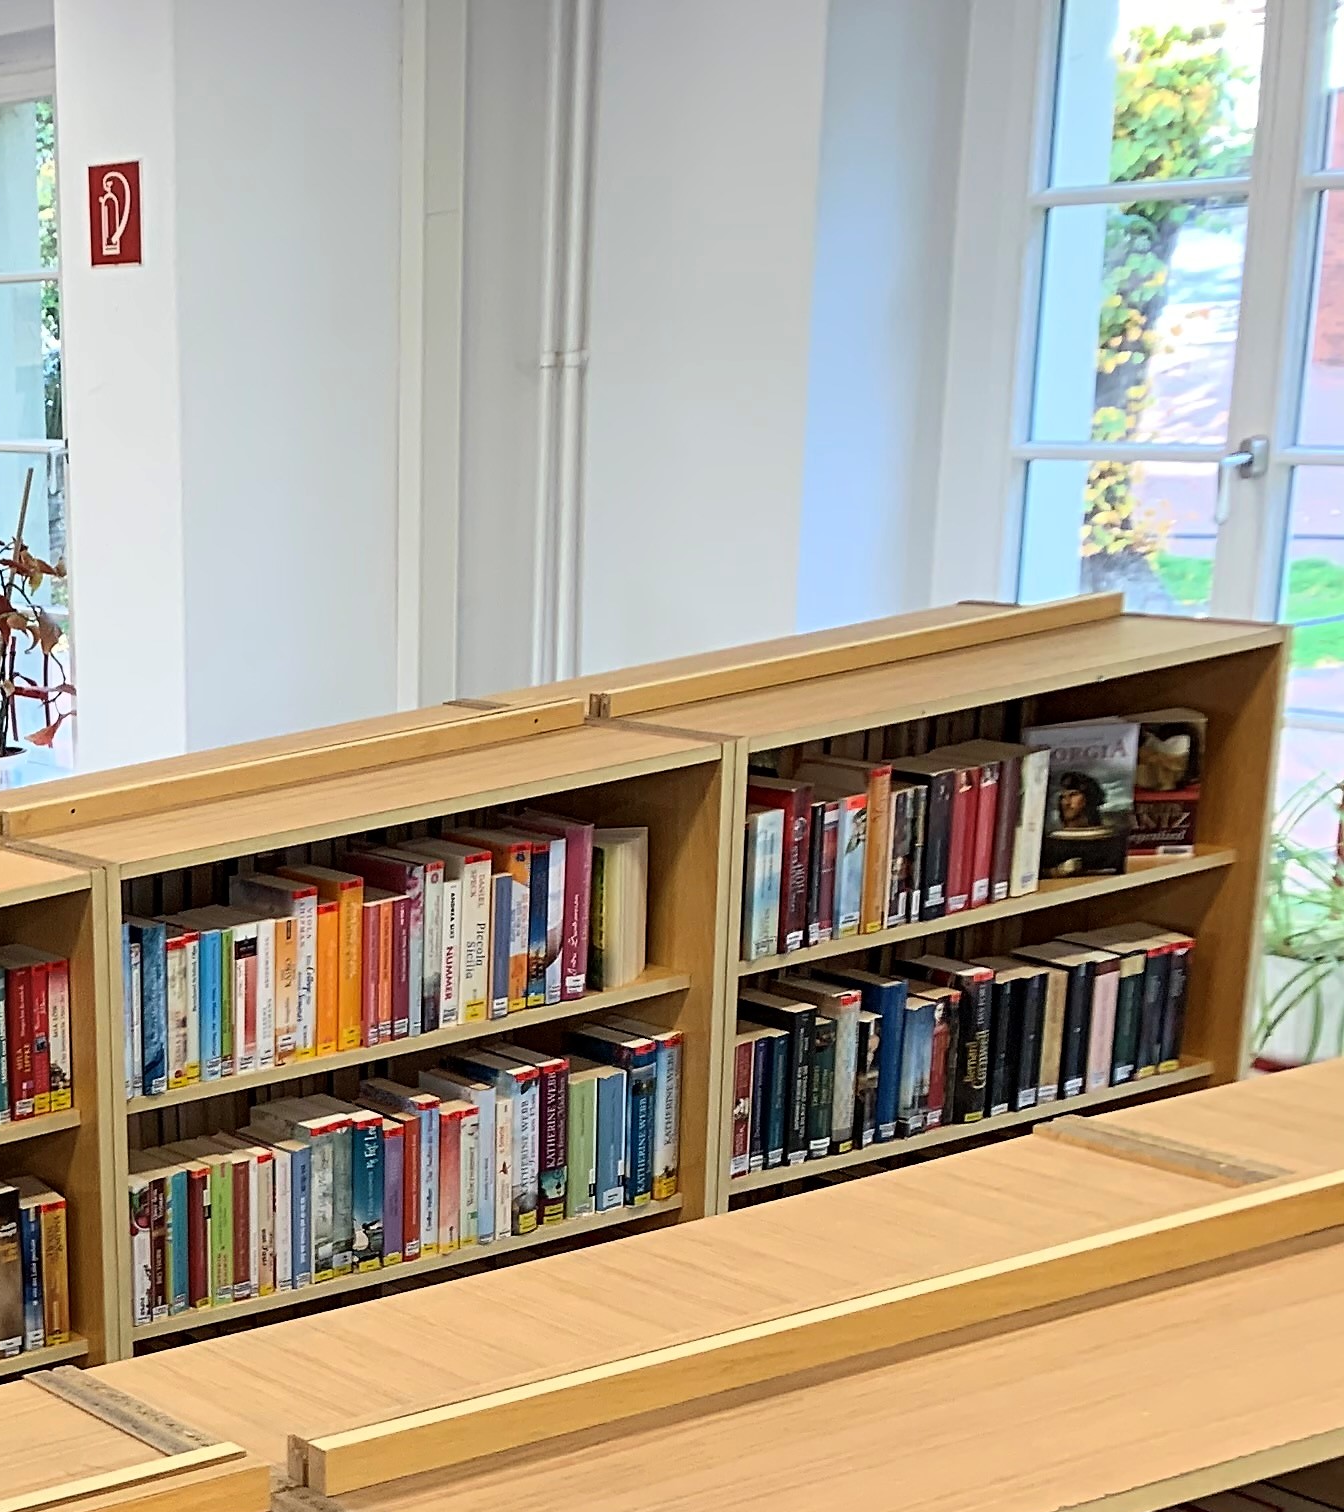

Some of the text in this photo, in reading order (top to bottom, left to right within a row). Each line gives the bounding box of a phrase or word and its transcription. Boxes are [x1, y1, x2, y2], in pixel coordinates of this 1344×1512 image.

[468, 868, 478, 899] SPECK
[476, 872, 487, 909] DANIEL
[464, 940, 477, 981] Sicilia
[475, 922, 488, 967] Piccola
[443, 945, 455, 1002] NUMMER
[963, 1040, 980, 1084] Bernard
[974, 1027, 991, 1089] Cornwell
[545, 1071, 558, 1170] KATHERINE WEBB
[664, 1086, 673, 1147] KATHERINE
[517, 1098, 531, 1199] KATHERINE WEBB
[637, 1097, 648, 1194] KATHERINE WEBB
